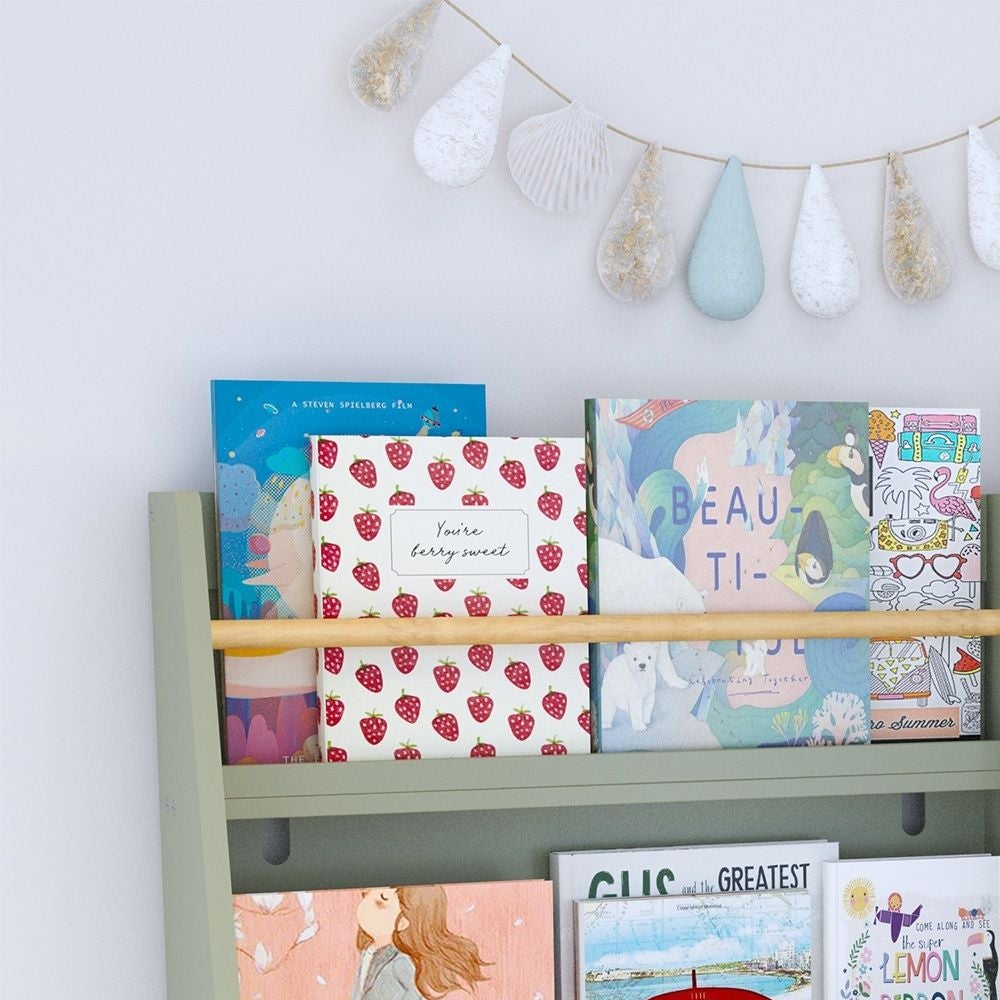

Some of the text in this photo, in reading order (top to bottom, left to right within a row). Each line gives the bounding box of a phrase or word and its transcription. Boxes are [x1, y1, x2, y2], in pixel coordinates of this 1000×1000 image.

[302, 400, 335, 409] STEVEN
[339, 401, 388, 409] SPIELBERG
[391, 400, 413, 410] FILM
[672, 486, 803, 525] BEAU-
[436, 520, 484, 538] You're
[410, 543, 510, 565] berry sweet
[706, 552, 767, 591] TI-
[762, 673, 809, 687] Together
[888, 715, 956, 731] Summer
[717, 863, 811, 892] GREATEST
[915, 920, 991, 932] COME ALONG AND SEE
[902, 935, 945, 951] the super
[879, 949, 960, 983] LEMON
